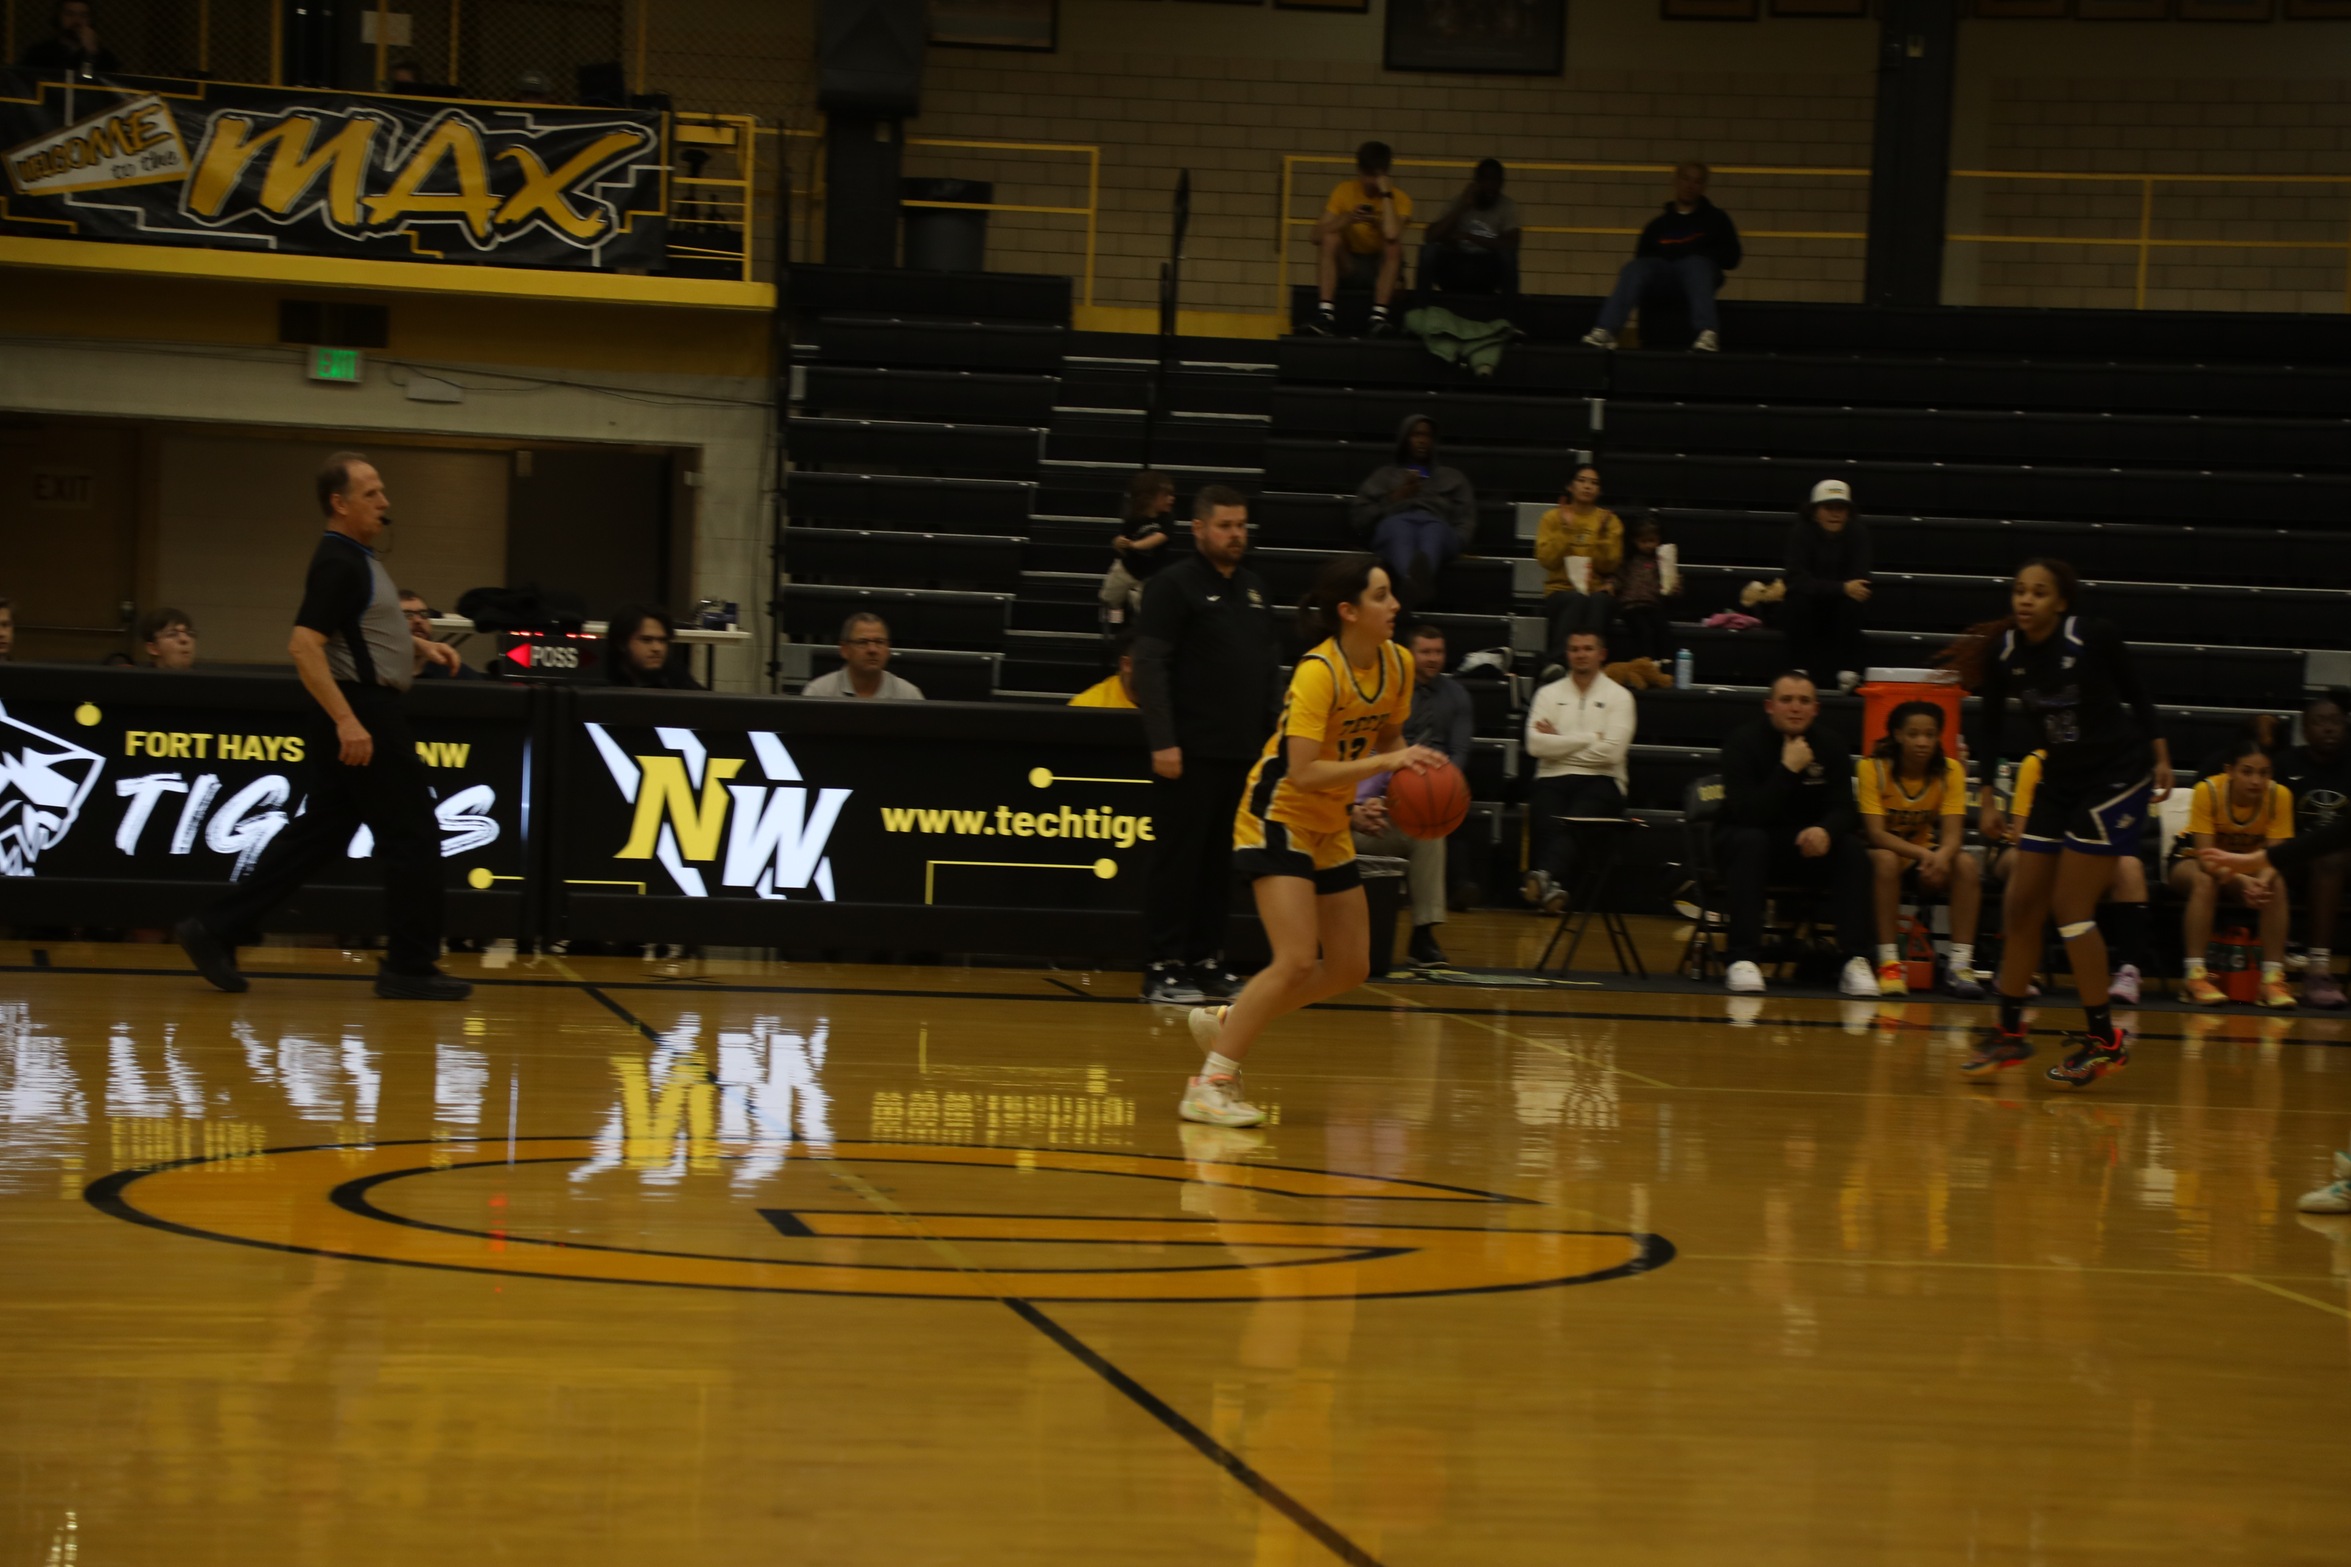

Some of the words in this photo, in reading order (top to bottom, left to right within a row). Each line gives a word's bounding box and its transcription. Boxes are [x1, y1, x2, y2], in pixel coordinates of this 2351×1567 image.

[16, 103, 174, 183] WELCOME
[112, 162, 137, 179] to
[141, 151, 179, 171] the
[187, 114, 646, 241] MAX
[317, 348, 357, 379] EXIT
[34, 473, 91, 502] EXIT
[530, 645, 579, 669] POSS
[124, 730, 214, 758] FORT
[217, 733, 306, 763] HAYS
[114, 771, 501, 883] TIGS
